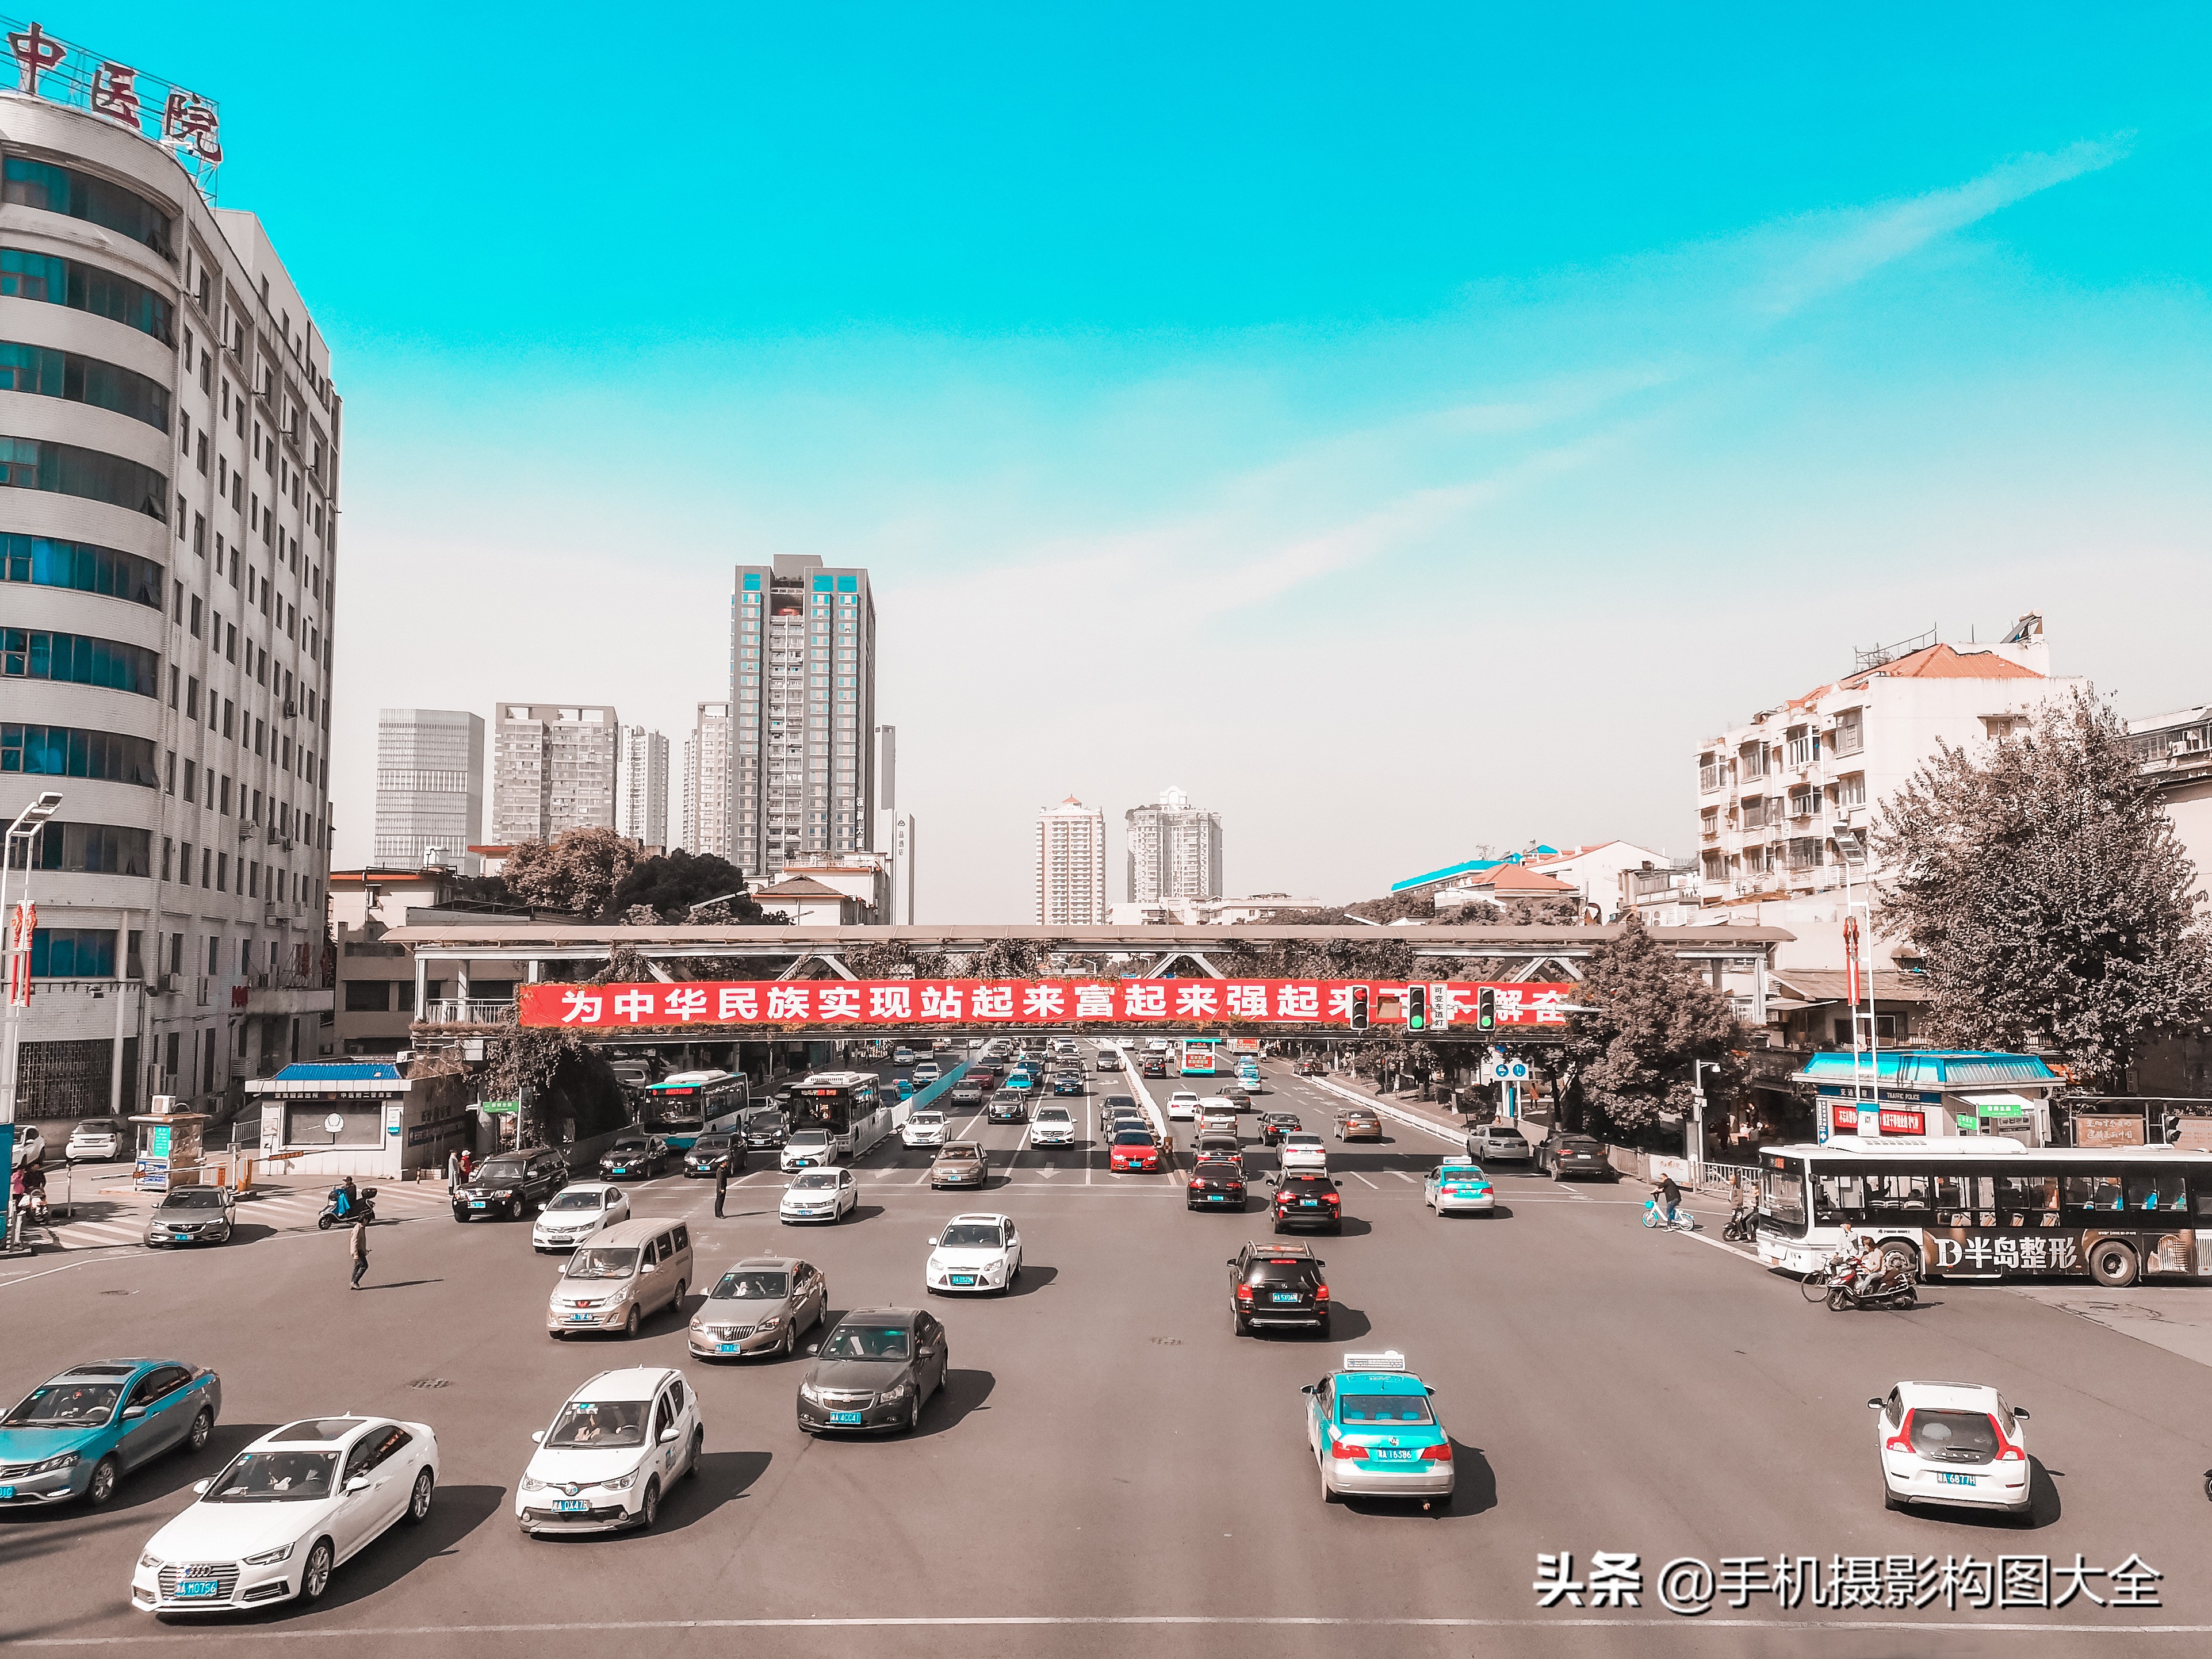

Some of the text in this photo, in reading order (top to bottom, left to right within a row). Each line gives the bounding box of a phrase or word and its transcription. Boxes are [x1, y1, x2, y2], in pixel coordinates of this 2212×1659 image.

[7, 21, 224, 163] 中医院
[1434, 987, 1444, 1026] 可变车道灯
[1840, 1088, 1867, 1097] 交通察
